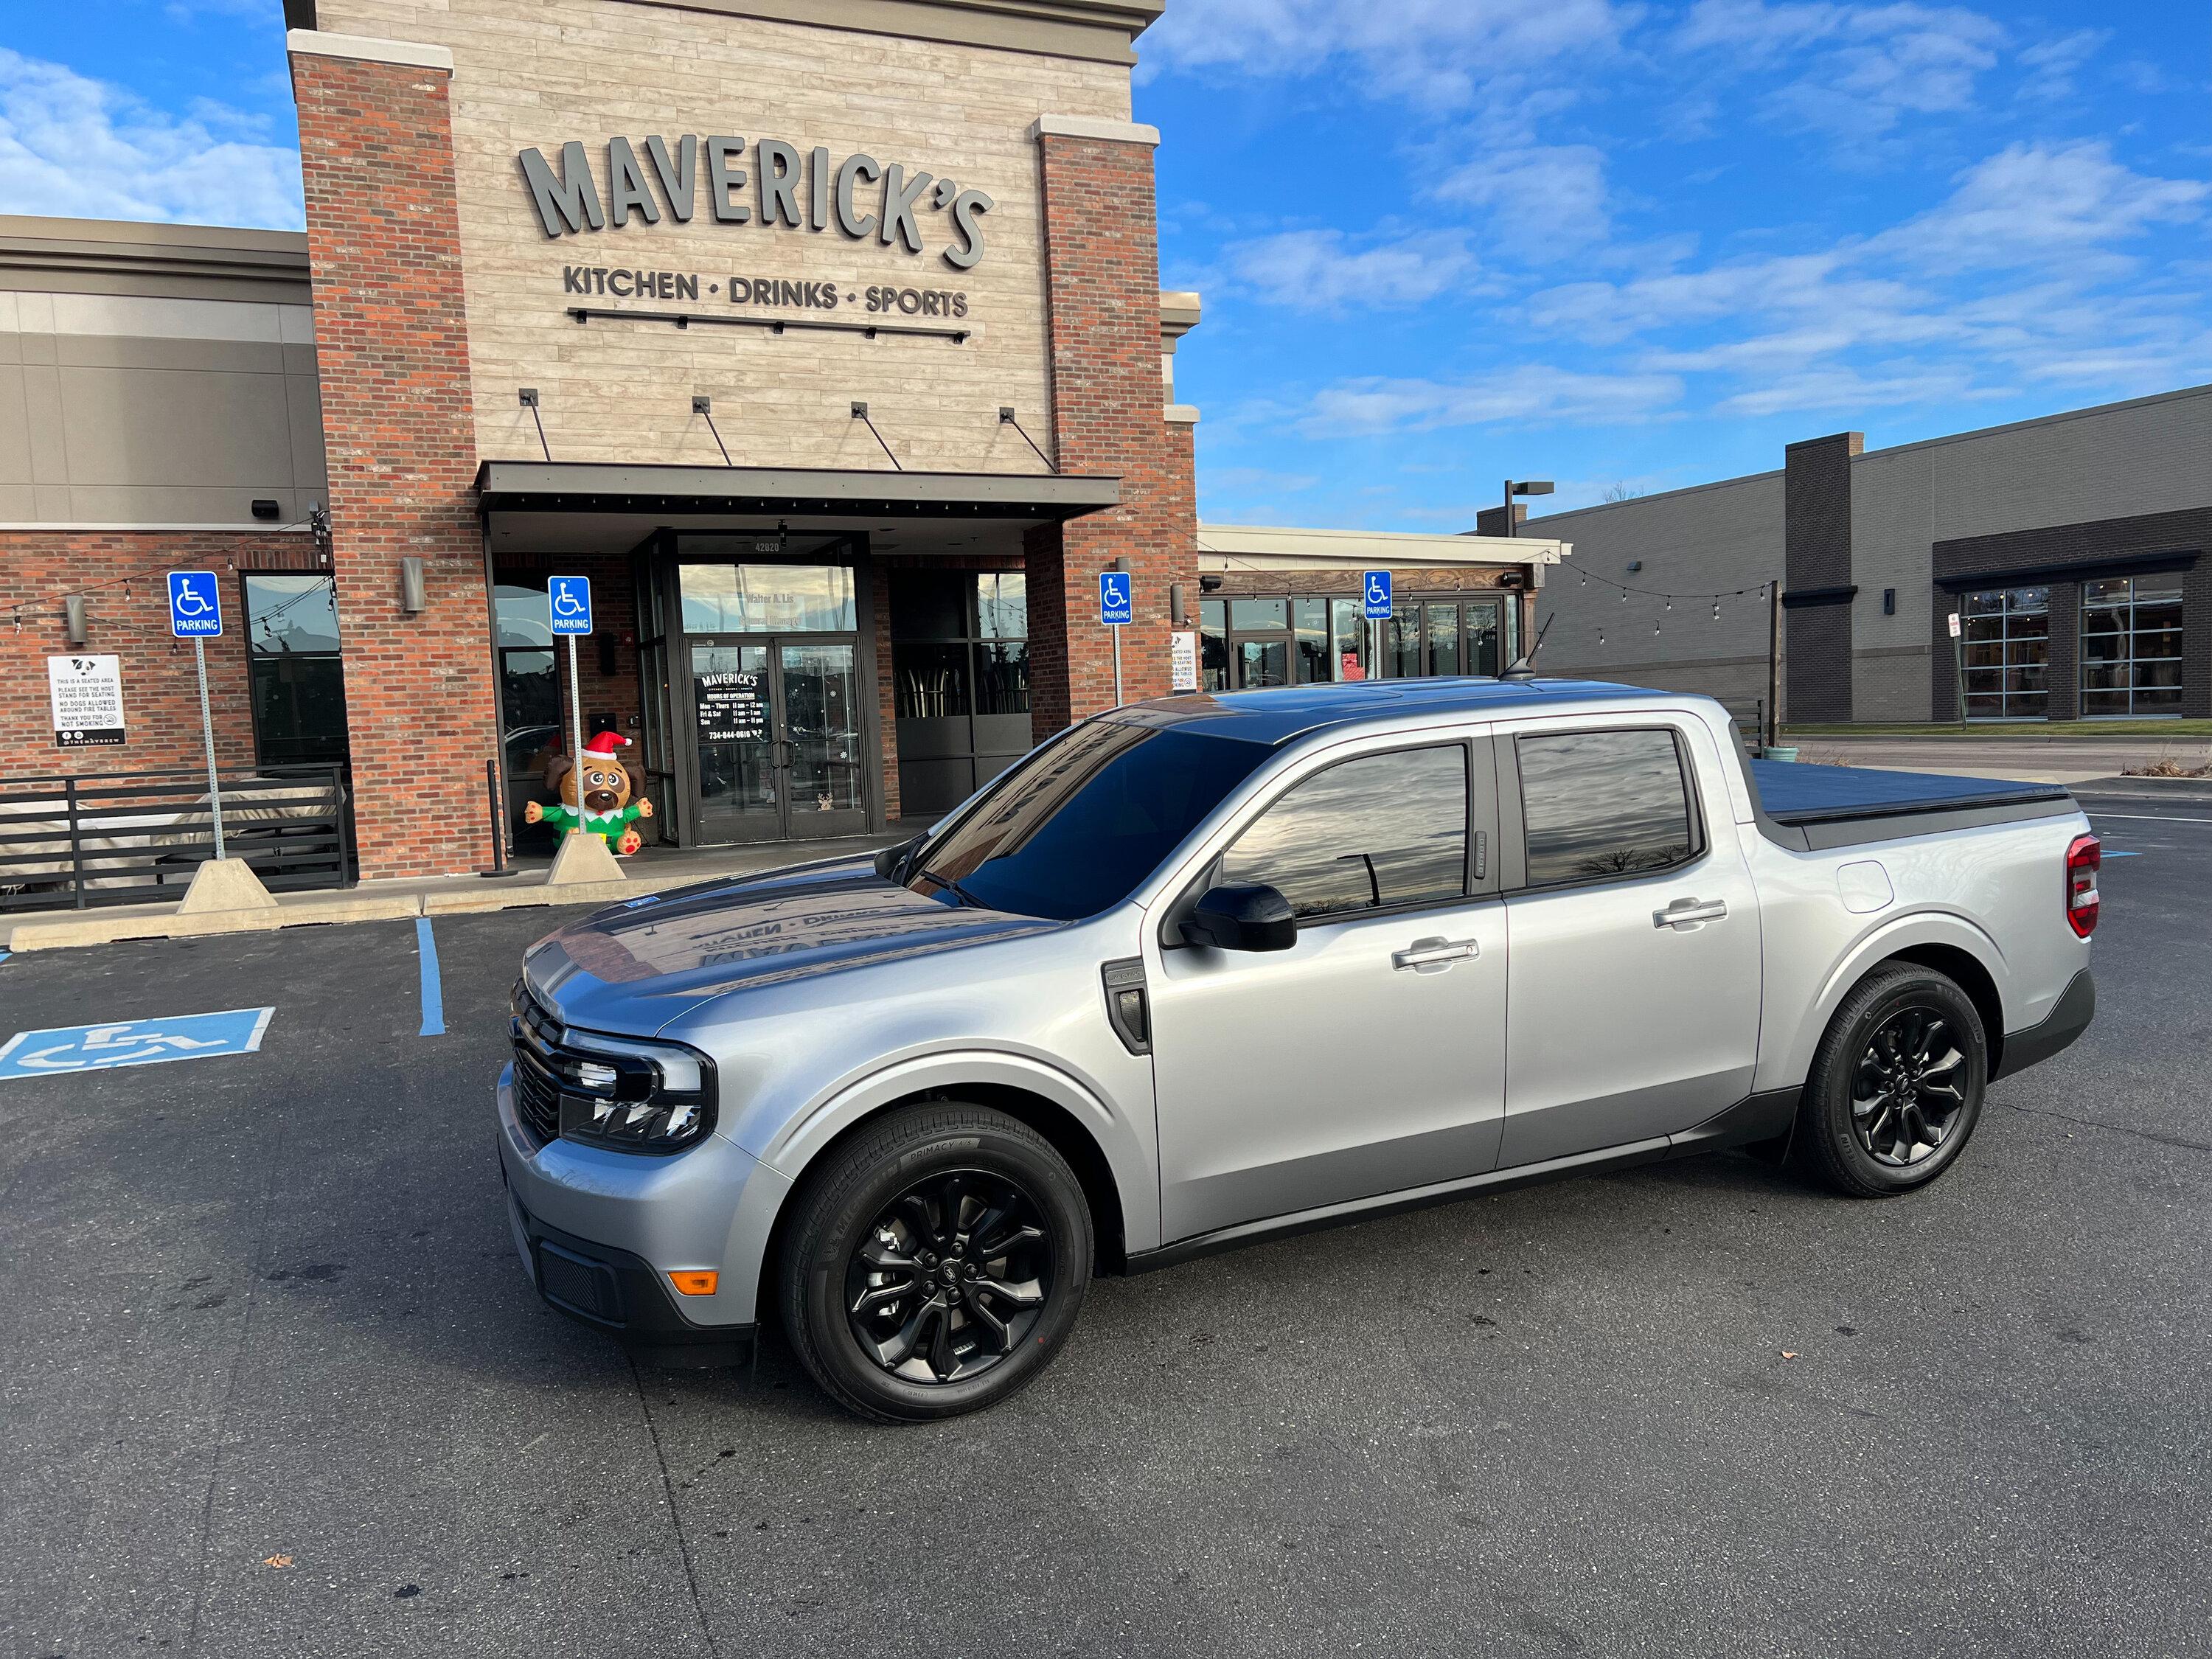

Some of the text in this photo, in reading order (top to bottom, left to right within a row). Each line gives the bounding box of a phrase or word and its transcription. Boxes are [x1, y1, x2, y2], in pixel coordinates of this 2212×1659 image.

[519, 134, 995, 269] MAVERICK'S
[563, 265, 969, 316] KITCHEN DRINKS SPORTS
[1104, 610, 1130, 619] PARKING
[1366, 606, 1390, 615] PARKING
[176, 619, 218, 630] PARKING
[554, 619, 588, 629] PARKING
[701, 672, 758, 687] MAVERICK'S
[910, 1141, 955, 1161] PRIMACY
